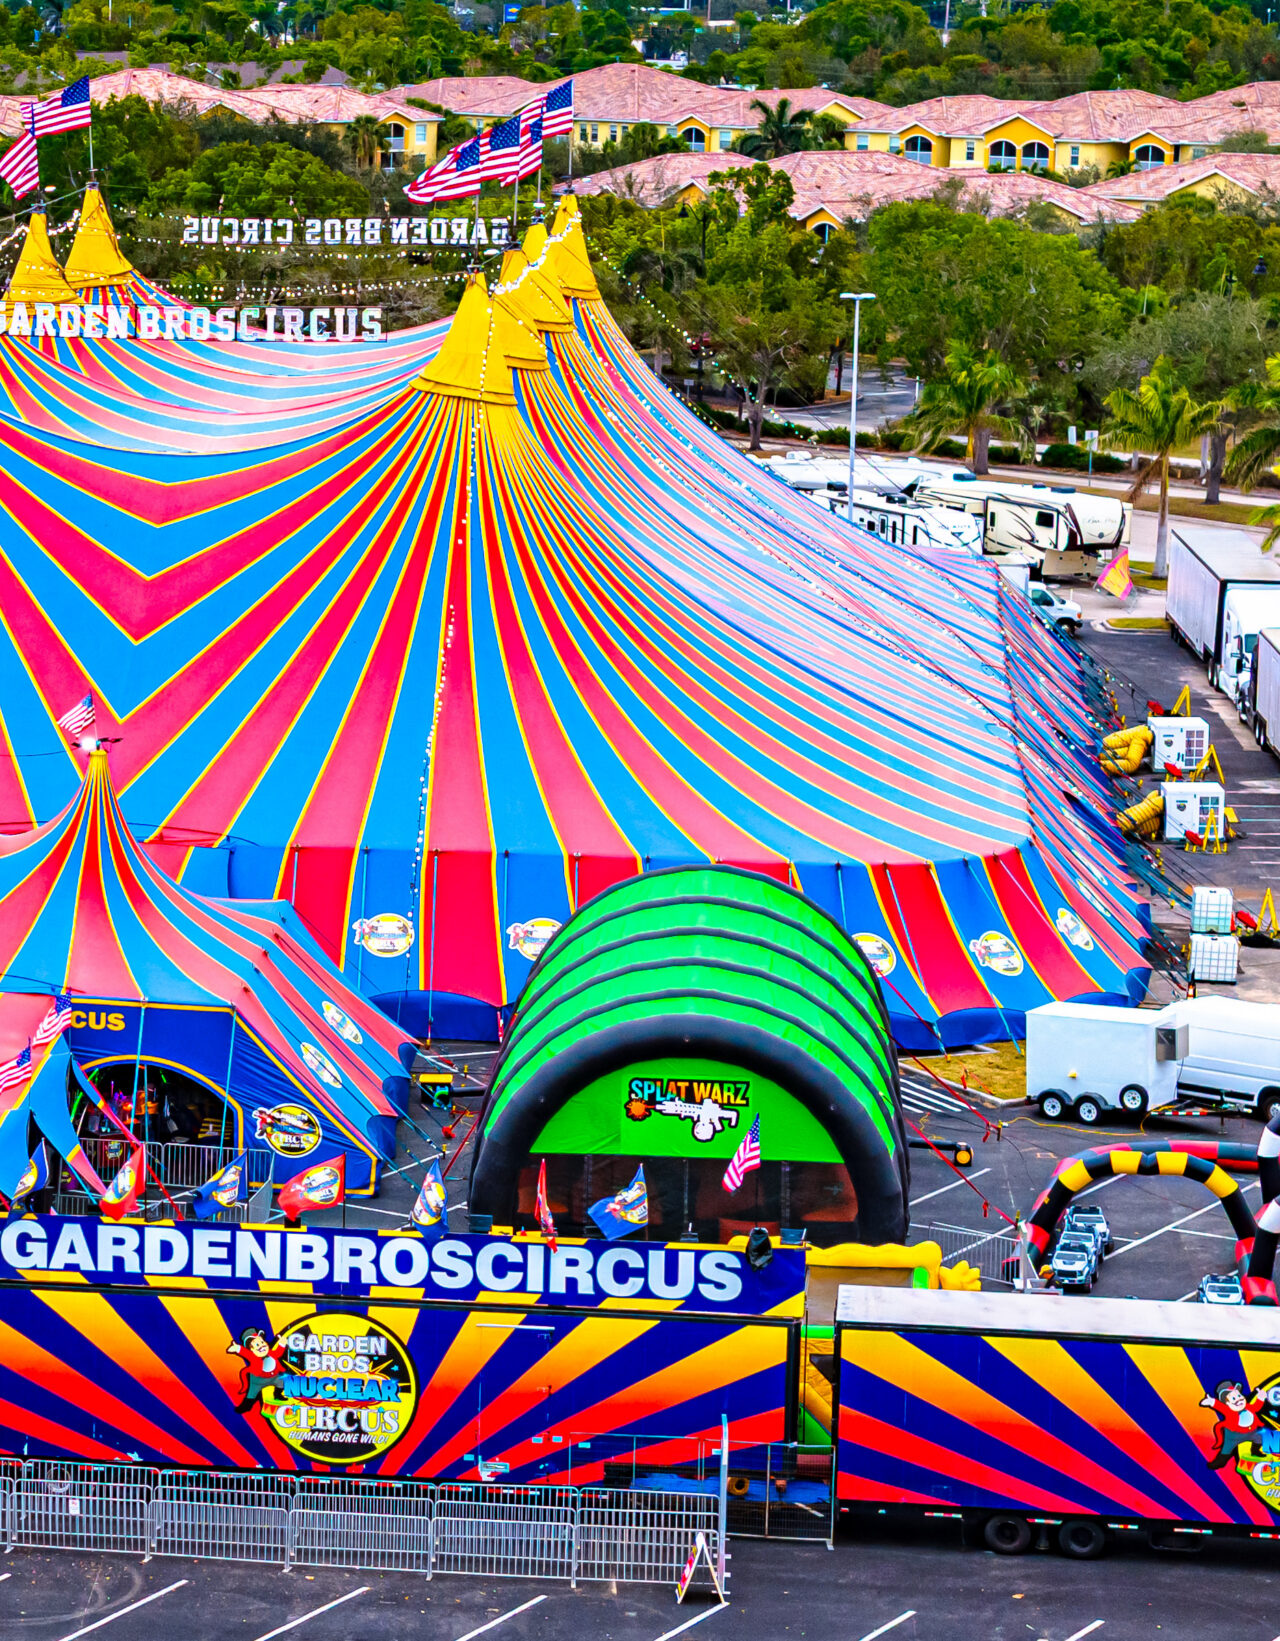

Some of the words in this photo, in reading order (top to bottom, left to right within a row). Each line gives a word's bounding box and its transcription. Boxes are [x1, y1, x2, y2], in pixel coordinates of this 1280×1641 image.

[631, 1079, 689, 1101] SPLAT
[692, 1081, 747, 1104] WARZ
[287, 1332, 388, 1356] GARDEN
[304, 1353, 370, 1373] BROS
[282, 1374, 402, 1402] NUCLEAR
[275, 1404, 400, 1434] CIRCUS
[288, 1430, 330, 1442] HUMANS
[331, 1432, 359, 1443] GONE
